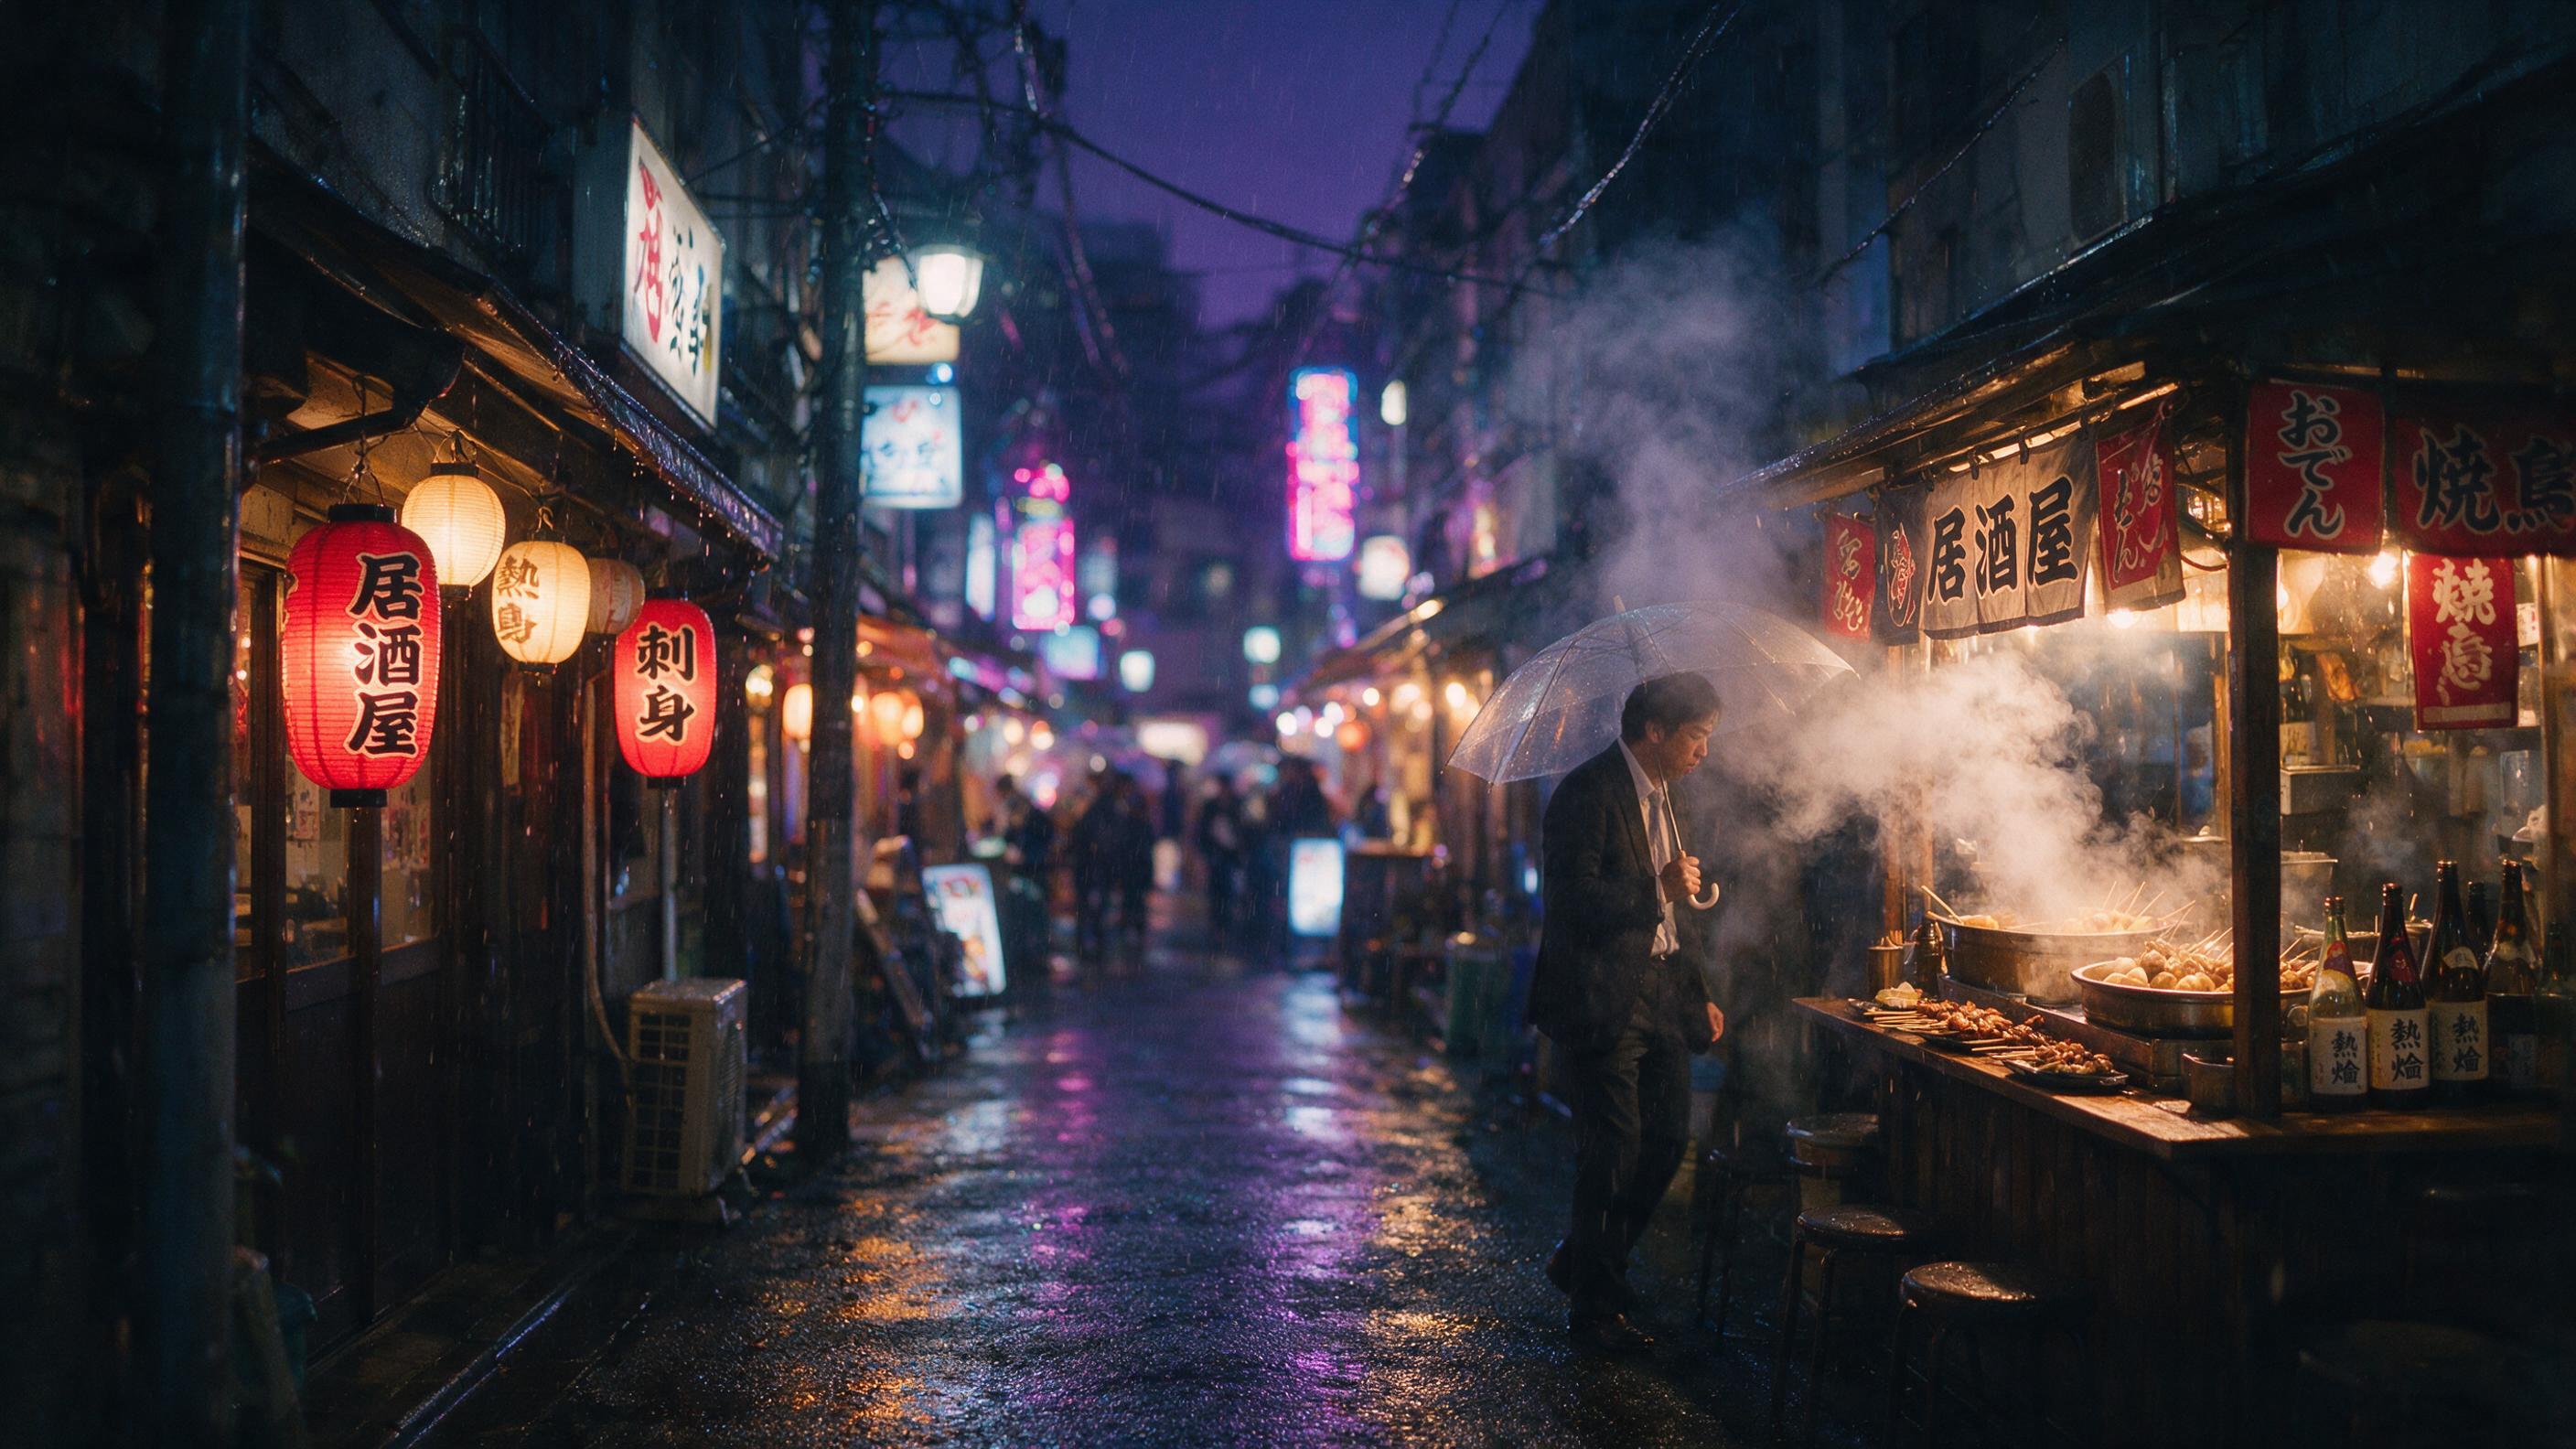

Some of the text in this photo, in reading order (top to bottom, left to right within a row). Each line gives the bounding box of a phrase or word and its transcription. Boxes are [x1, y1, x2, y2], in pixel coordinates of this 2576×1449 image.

[2278, 391, 2352, 539] おでん
[1927, 476, 2078, 604] 居酒屋
[348, 553, 425, 757] 居酒屋
[636, 624, 696, 743] 刺身
